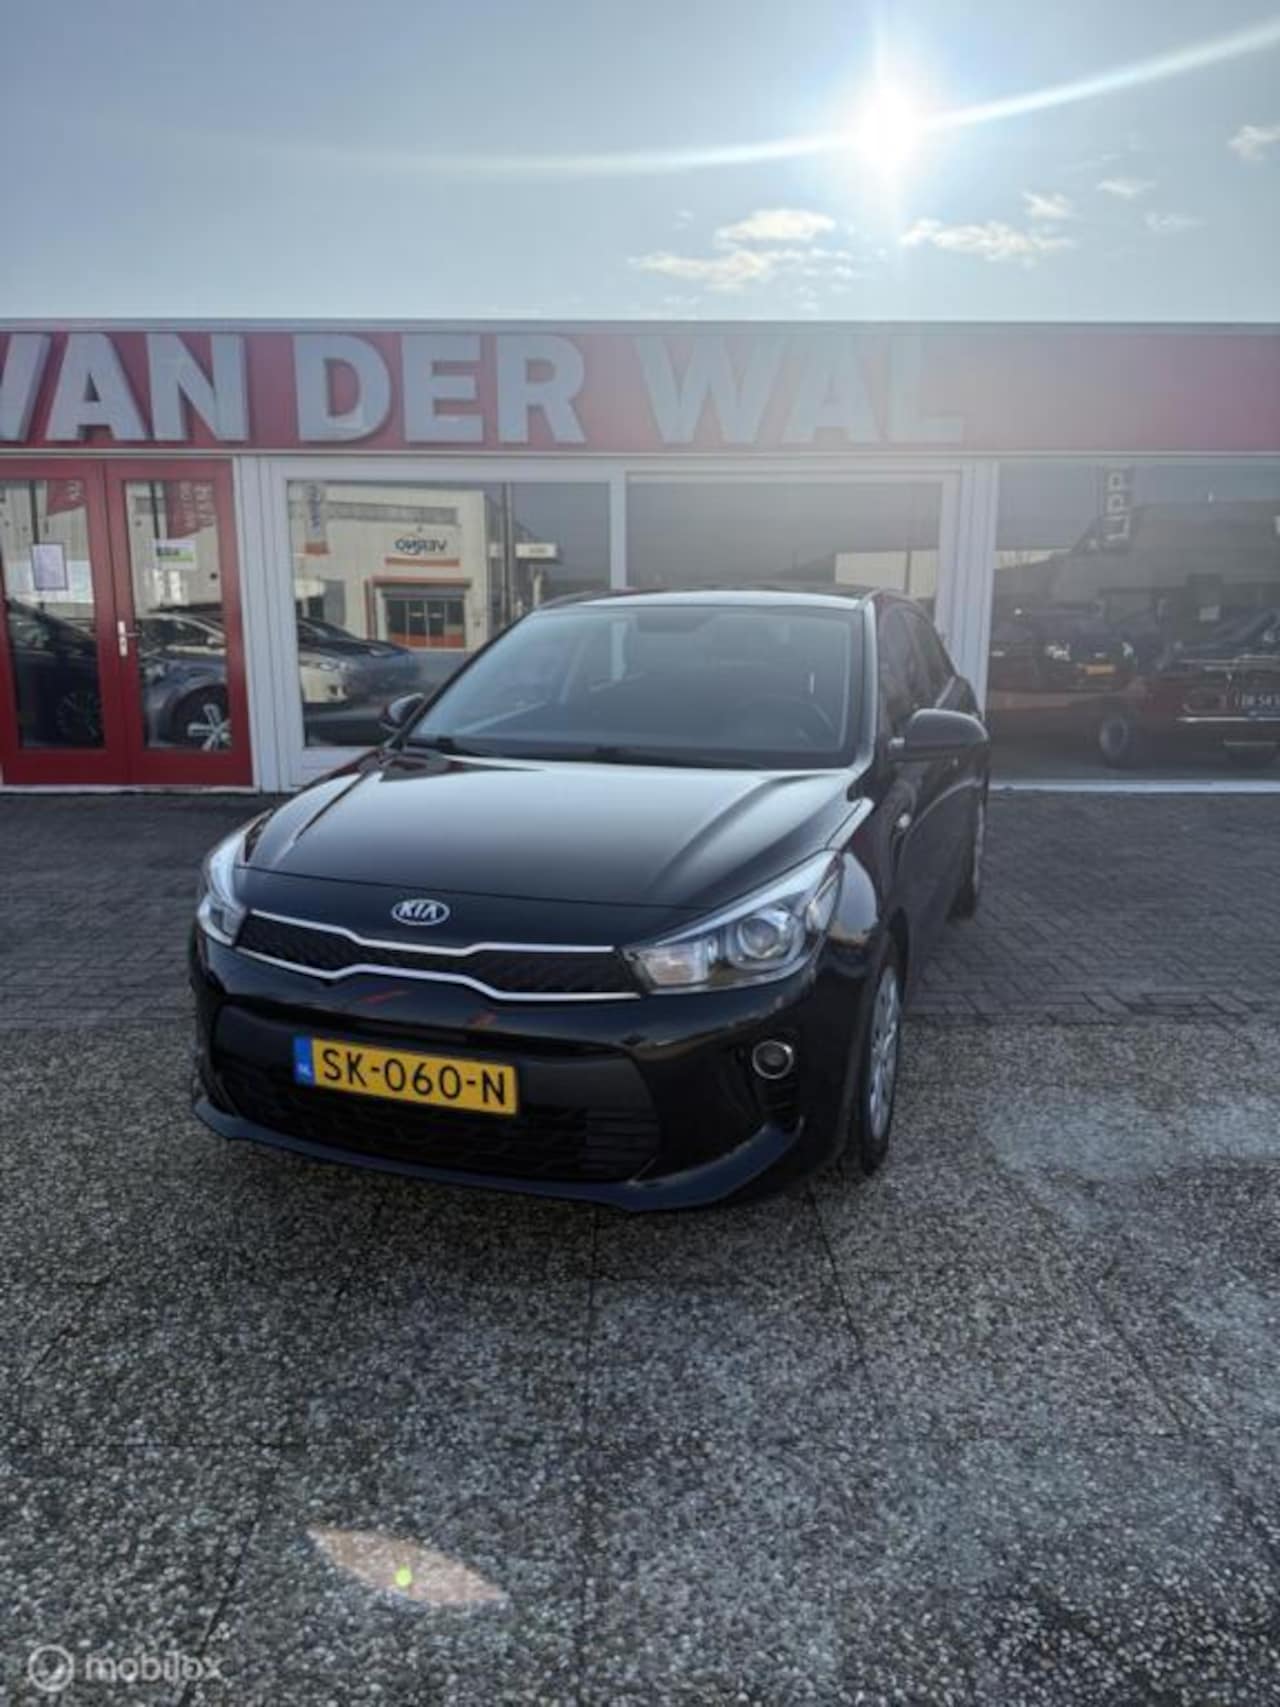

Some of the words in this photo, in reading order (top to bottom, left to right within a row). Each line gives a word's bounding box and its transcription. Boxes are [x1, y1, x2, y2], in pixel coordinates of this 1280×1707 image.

[293, 334, 587, 443] DER
[635, 334, 963, 444] WAL
[397, 900, 440, 921] KIA
[322, 1048, 505, 1104] SK-060-N
